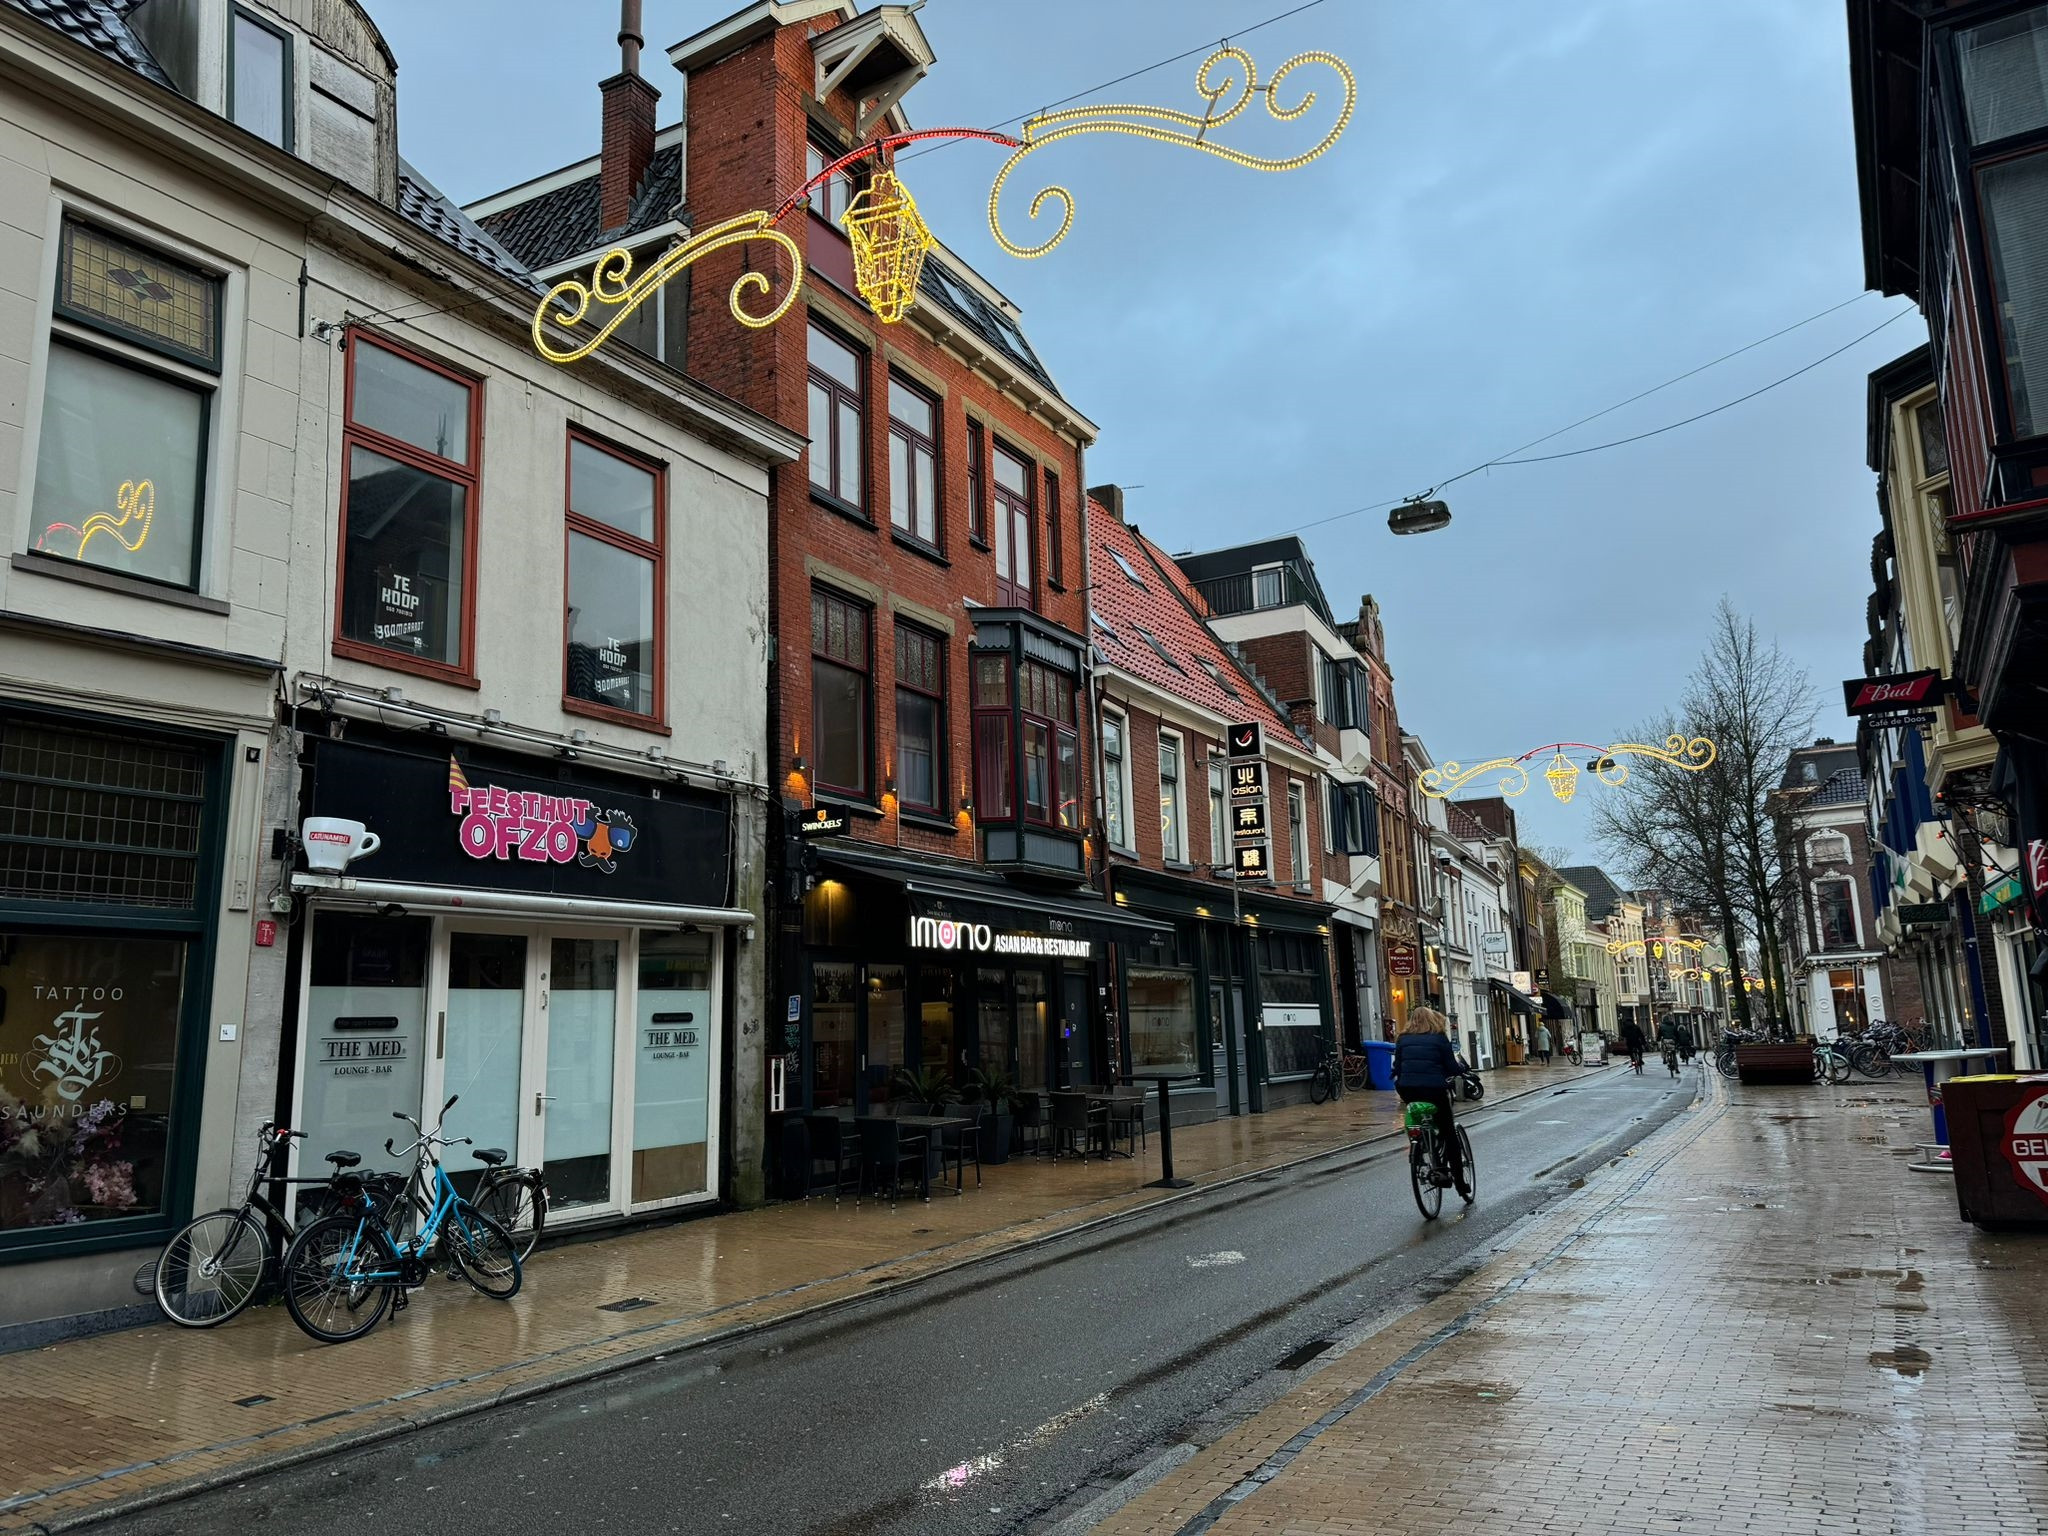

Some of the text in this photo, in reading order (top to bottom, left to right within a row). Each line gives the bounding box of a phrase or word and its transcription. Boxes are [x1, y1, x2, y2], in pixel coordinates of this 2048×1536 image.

[393, 574, 411, 593] TE
[607, 636, 620, 652] TE
[1865, 681, 1915, 702] Bud
[1904, 716, 1926, 724] Doos
[1232, 785, 1262, 795] asian
[451, 784, 590, 826] FEESTHUT
[459, 813, 578, 864] OFZO
[995, 934, 1021, 954] ASIAN
[1043, 938, 1091, 958] RESTAURANT
[33, 986, 123, 1001] TATTOO
[648, 1031, 696, 1045] THE MED
[328, 1040, 401, 1057] THE MED
[652, 1051, 675, 1059] LOUNGE
[334, 1066, 370, 1076] LOUNGE
[375, 1065, 393, 1074] BAR
[0, 1102, 128, 1120] SAUNDERS
